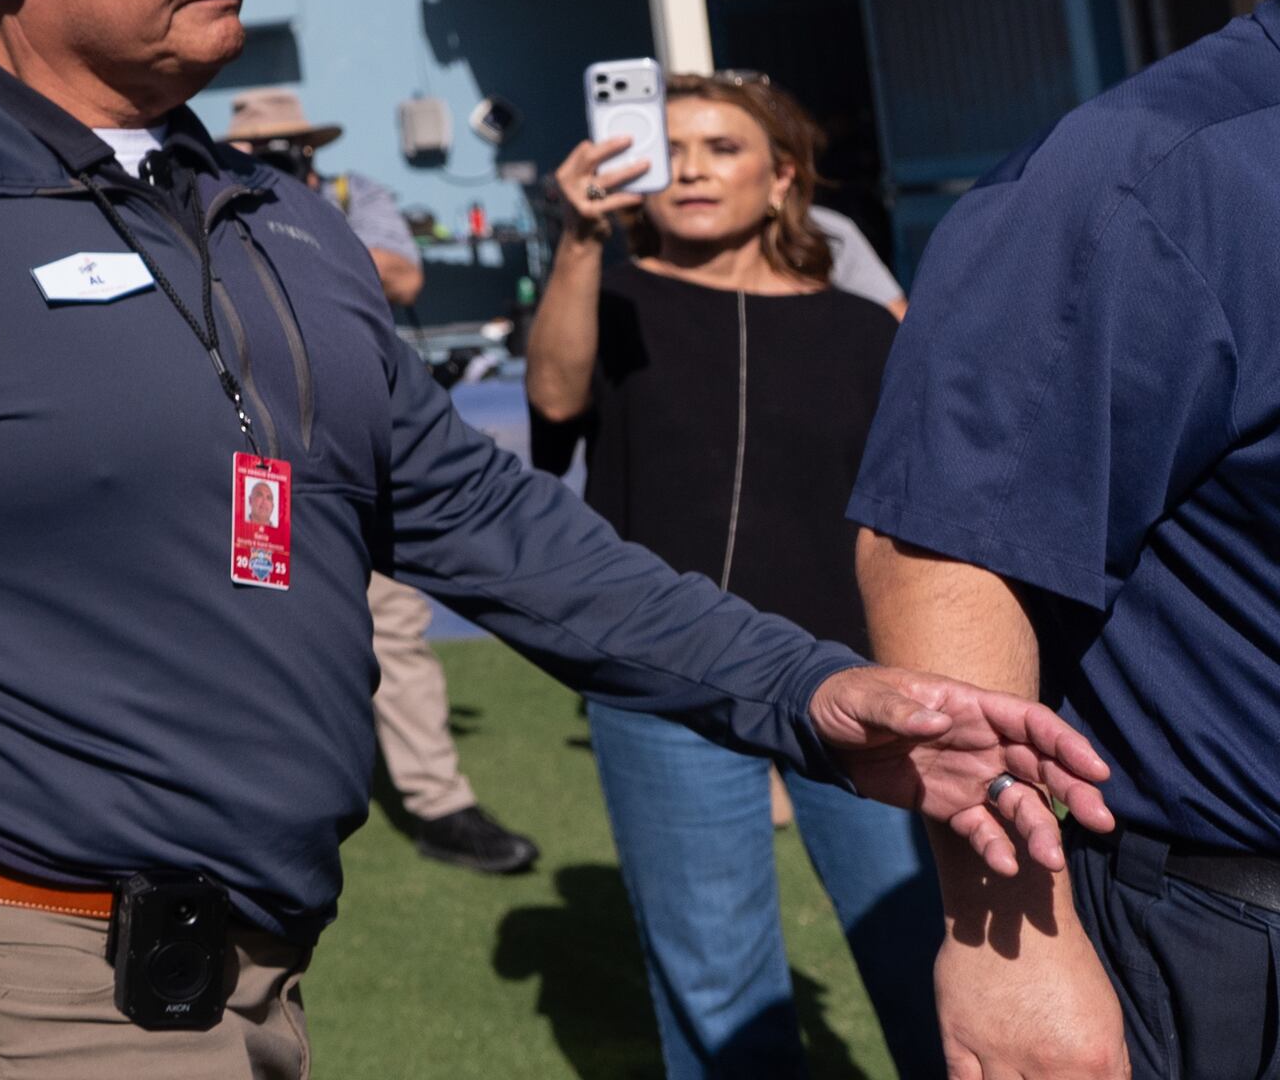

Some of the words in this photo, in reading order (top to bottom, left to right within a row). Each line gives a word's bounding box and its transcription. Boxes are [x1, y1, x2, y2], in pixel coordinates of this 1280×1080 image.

[89, 275, 106, 286] AL
[236, 555, 248, 569] 20
[275, 562, 286, 575] 25
[165, 1003, 190, 1012] AXON
